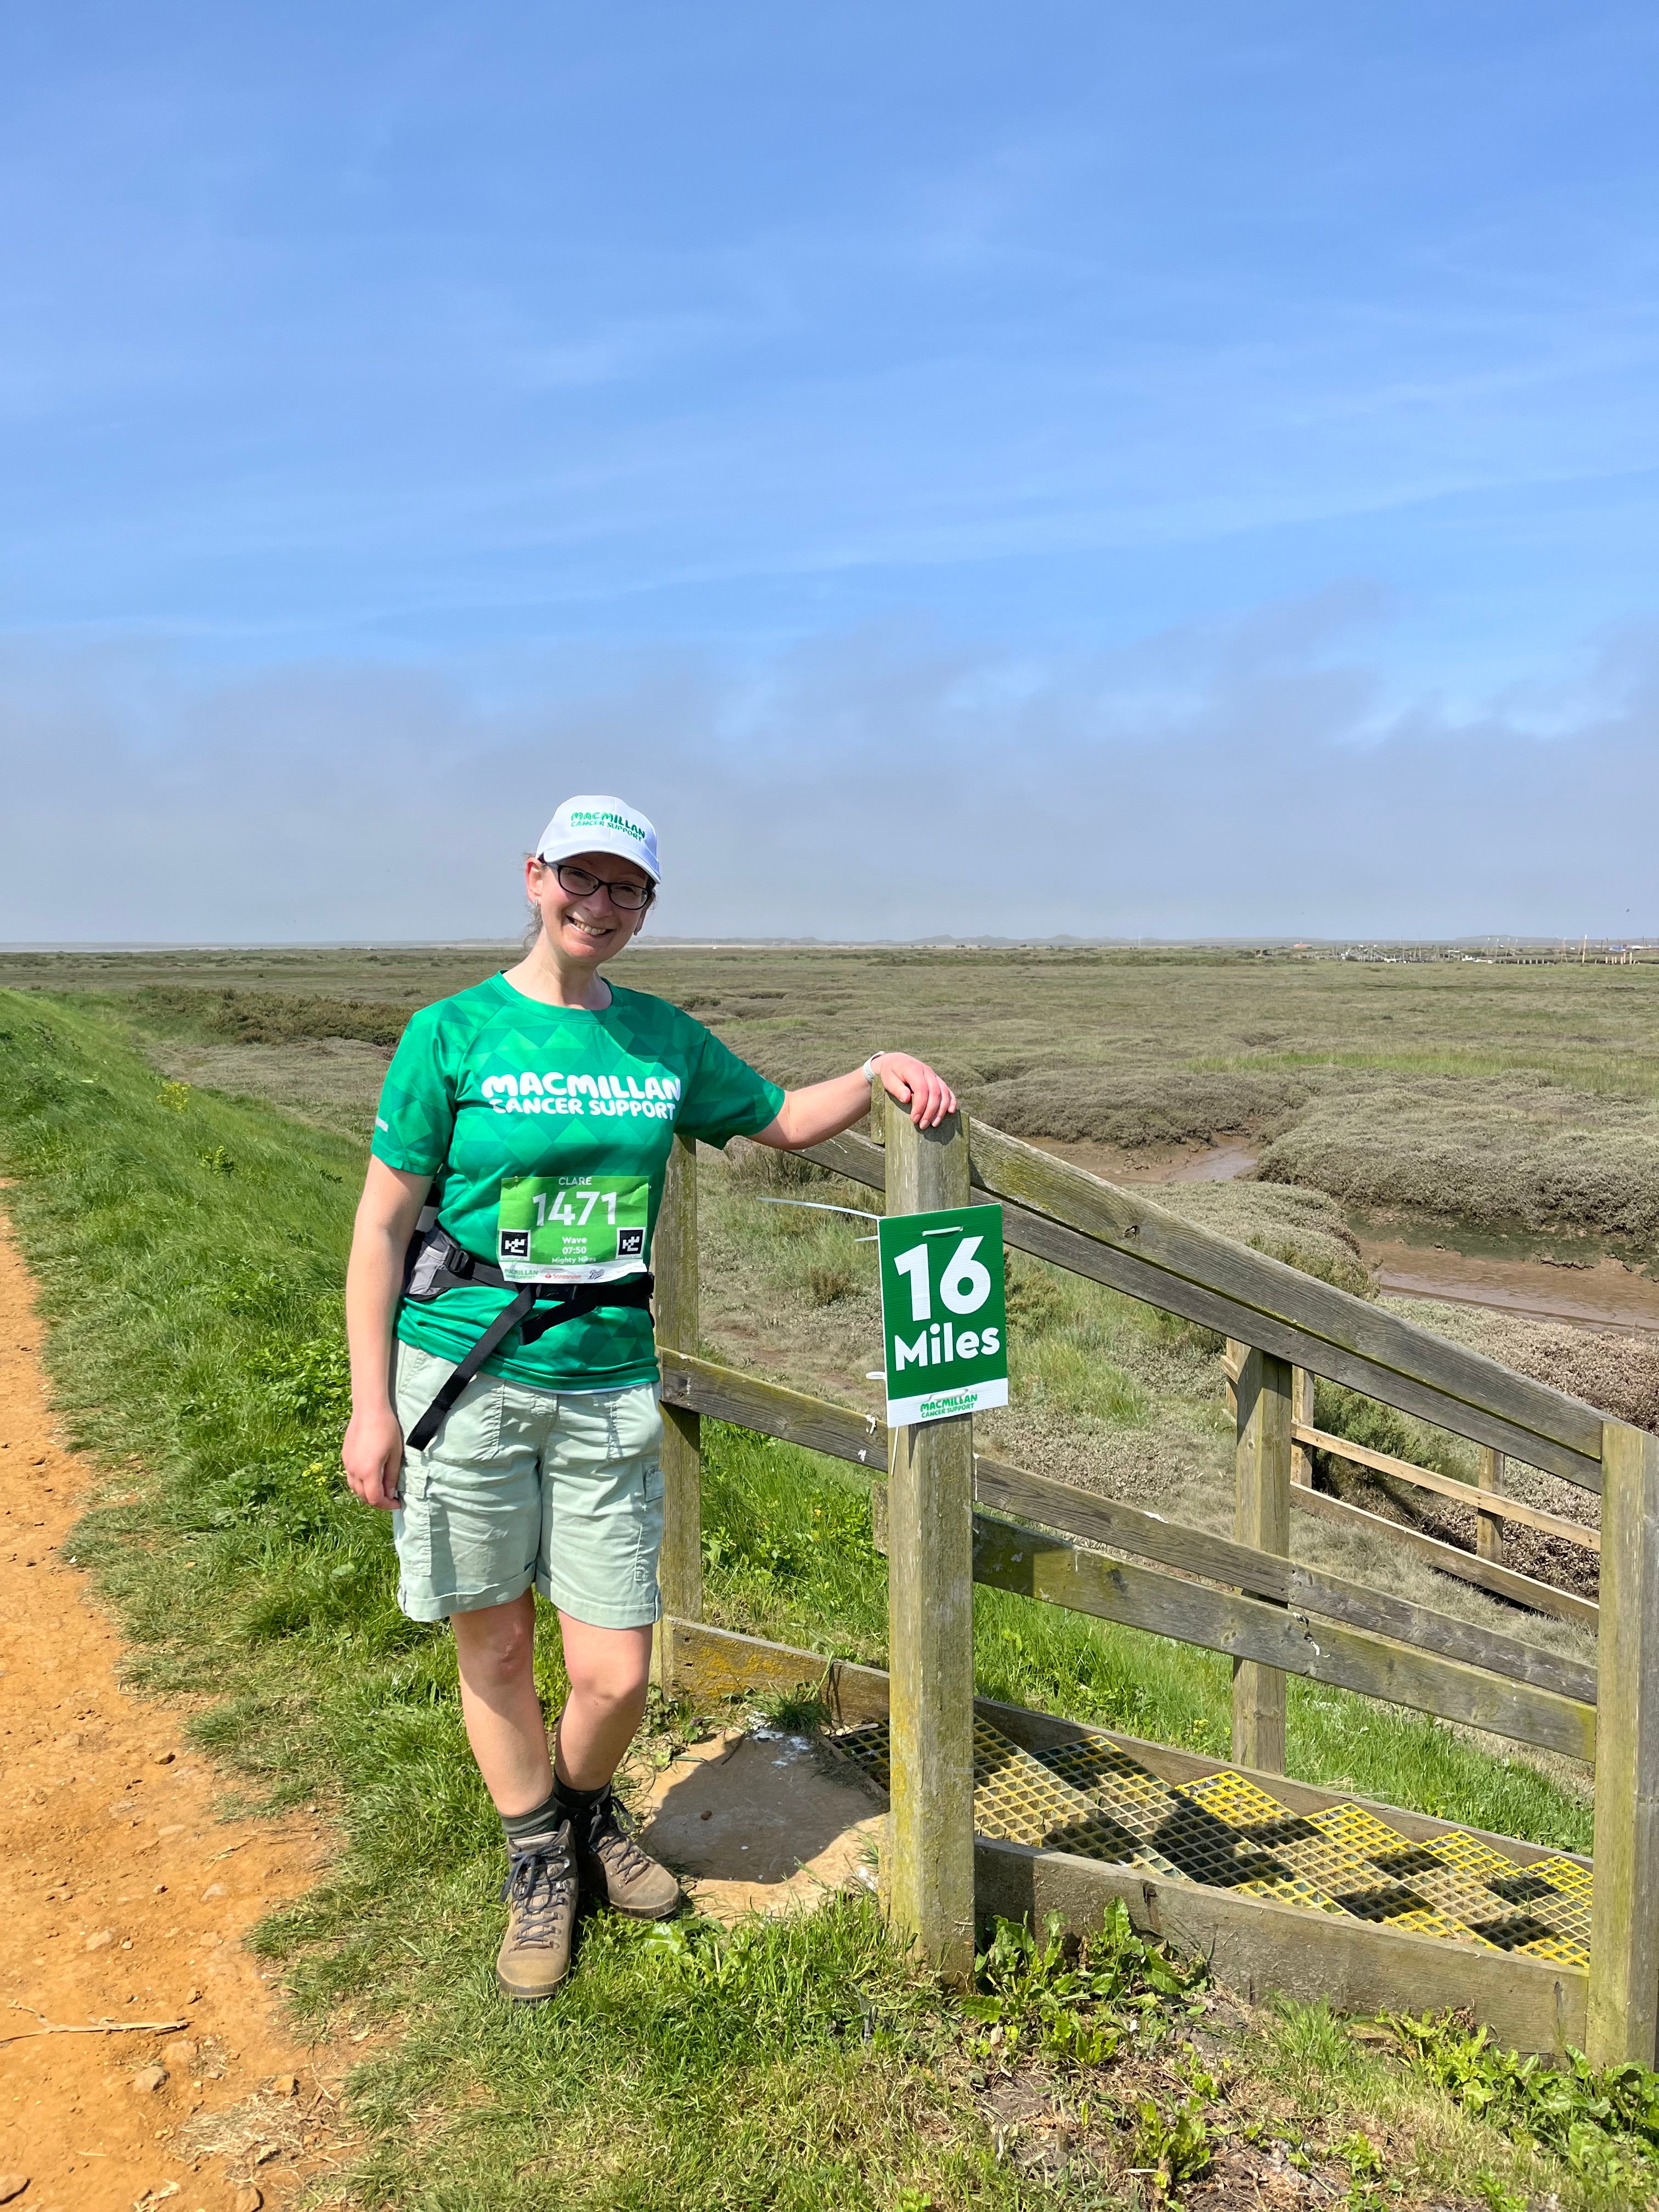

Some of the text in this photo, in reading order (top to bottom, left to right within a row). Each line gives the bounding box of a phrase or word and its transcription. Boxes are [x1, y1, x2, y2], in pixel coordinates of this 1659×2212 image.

[571, 812, 645, 839] MACMILLAN
[606, 822, 642, 842] SUPPORT
[482, 1072, 681, 1101] MACMILLAN
[490, 1098, 676, 1120] CANCER SUPPORT
[558, 1177, 592, 1186] CLARE
[532, 1191, 617, 1226] 1471
[894, 1235, 991, 1322] 16
[895, 1322, 1000, 1371] Miles
[920, 1393, 978, 1412] MACMILLAN
[922, 1403, 975, 1418] CANCER SUPPORT
